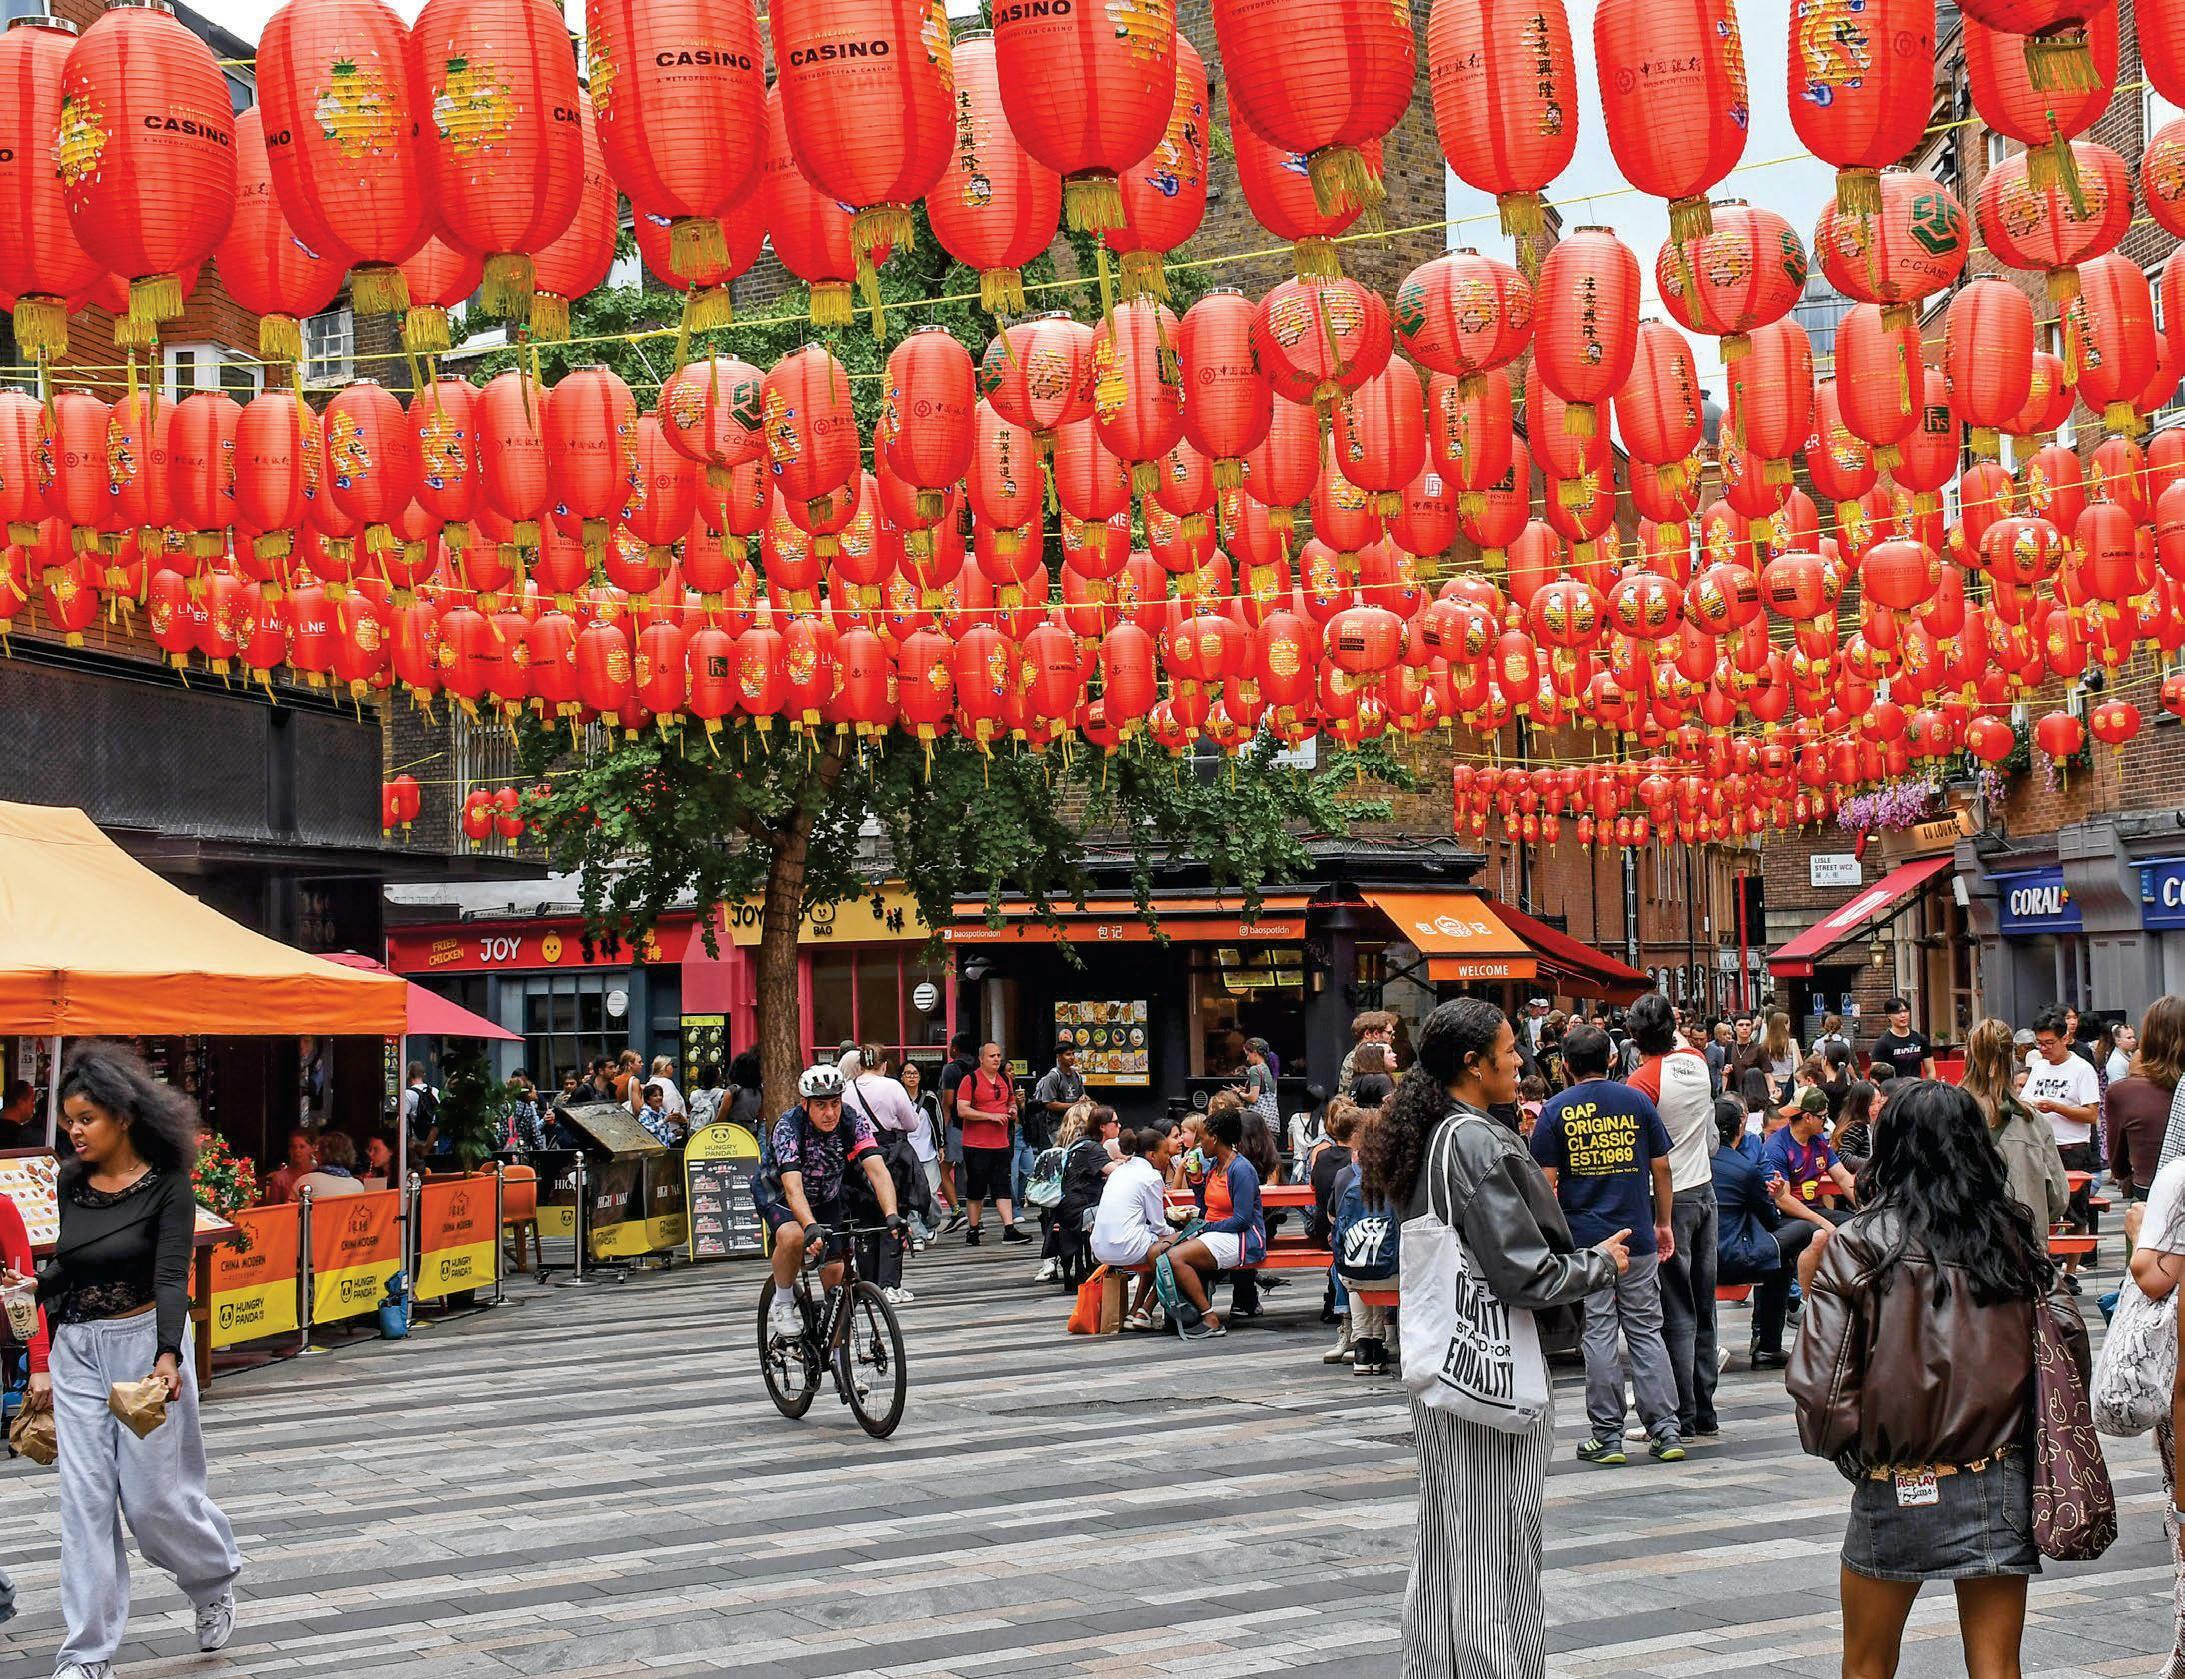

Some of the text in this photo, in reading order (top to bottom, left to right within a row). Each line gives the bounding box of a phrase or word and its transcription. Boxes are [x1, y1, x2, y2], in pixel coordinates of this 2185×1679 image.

[656, 51, 752, 71] CASINO
[790, 40, 890, 67] CASINO
[144, 115, 230, 147] CASINO
[1814, 856, 1831, 864] LISLE
[2010, 885, 2063, 917] CORAL
[2163, 877, 2185, 908] C
[732, 904, 766, 927] JOY
[813, 925, 833, 937] BAO
[953, 928, 1001, 939] baospotlondon
[1249, 924, 1291, 937] baospotldn
[432, 938, 458, 954] FRIED
[479, 936, 522, 963] JOY
[428, 947, 465, 967] CHICKEN
[1458, 964, 1509, 977] WELCOME
[1561, 1102, 1598, 1121] GAP
[1564, 1114, 1640, 1137] ORIGINAL
[704, 1143, 738, 1152] HUNGRY
[1567, 1130, 1636, 1152] CLASSIC
[704, 1150, 731, 1158] PANDA
[1569, 1146, 1634, 1167] EST.1969
[221, 1260, 240, 1272] CHINA
[353, 1275, 377, 1289] HUNGRY
[353, 1288, 370, 1300] PANDA
[235, 1298, 265, 1313] HUNGRY
[235, 1311, 259, 1326] PANDA
[1442, 1336, 1514, 1400] EQUALITY
